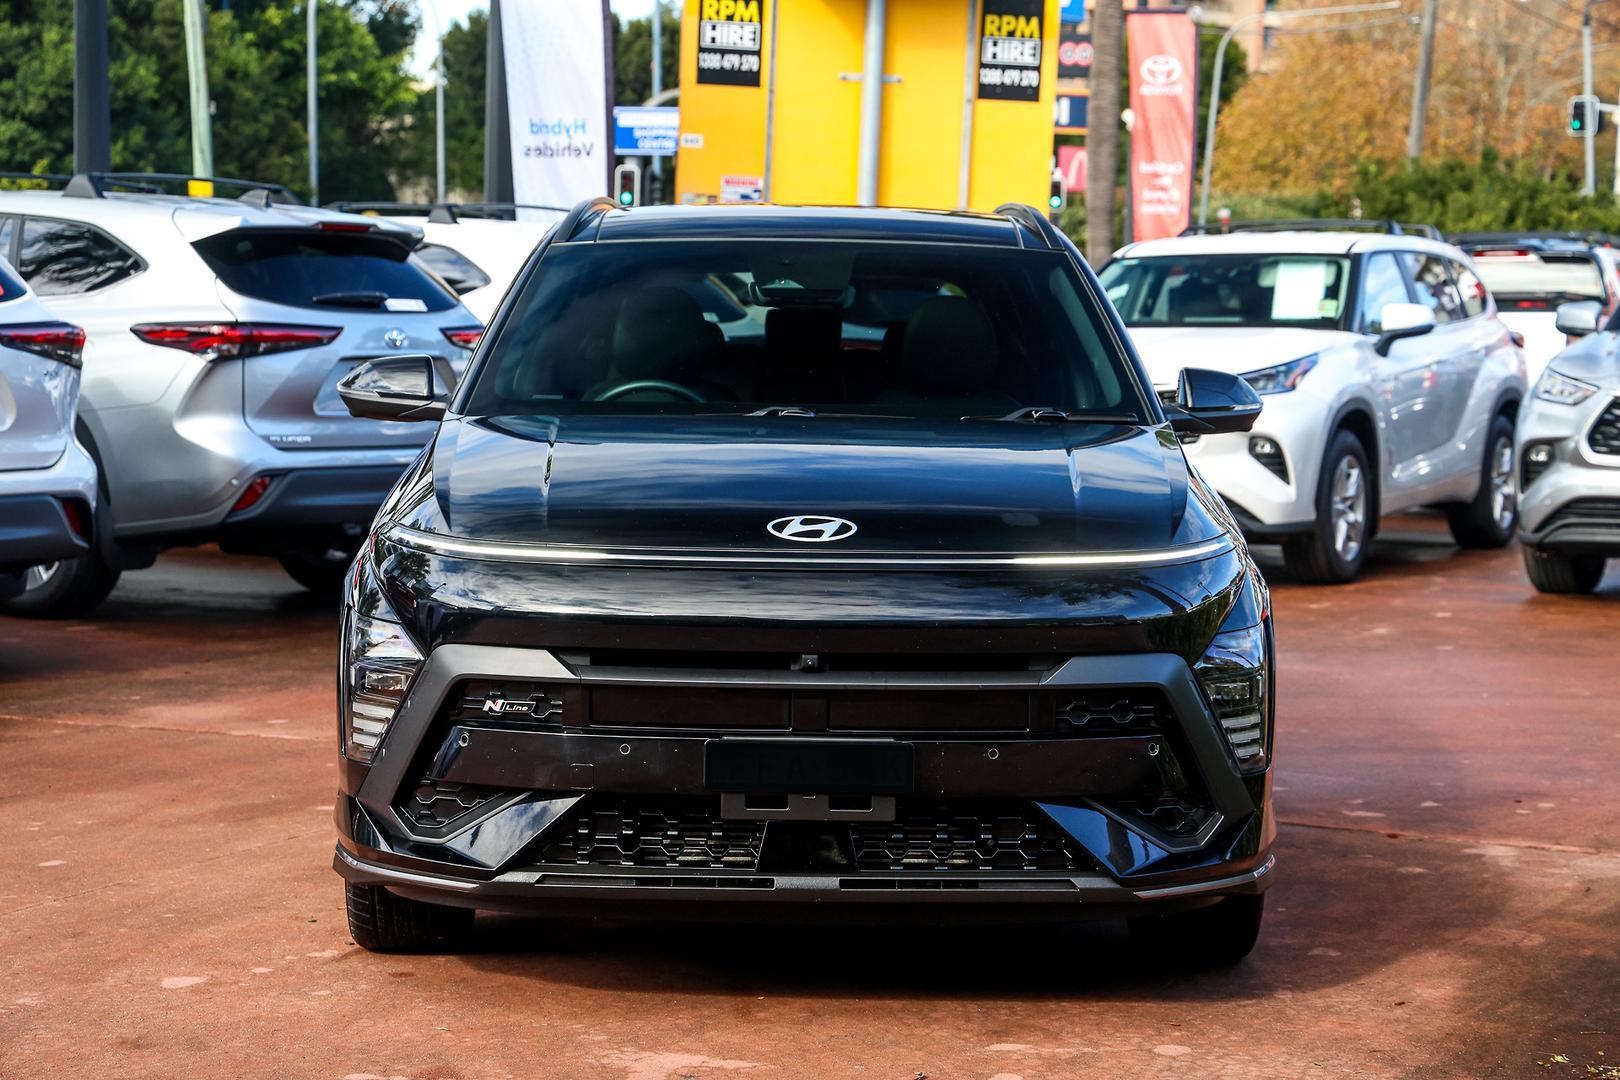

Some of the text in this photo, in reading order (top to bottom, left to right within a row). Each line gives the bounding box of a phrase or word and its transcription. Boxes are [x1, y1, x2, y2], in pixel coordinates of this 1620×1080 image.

[702, 0, 760, 23] RPM
[704, 22, 758, 48] HIRE
[984, 14, 1041, 39] RPM
[985, 39, 1037, 63] HIRE
